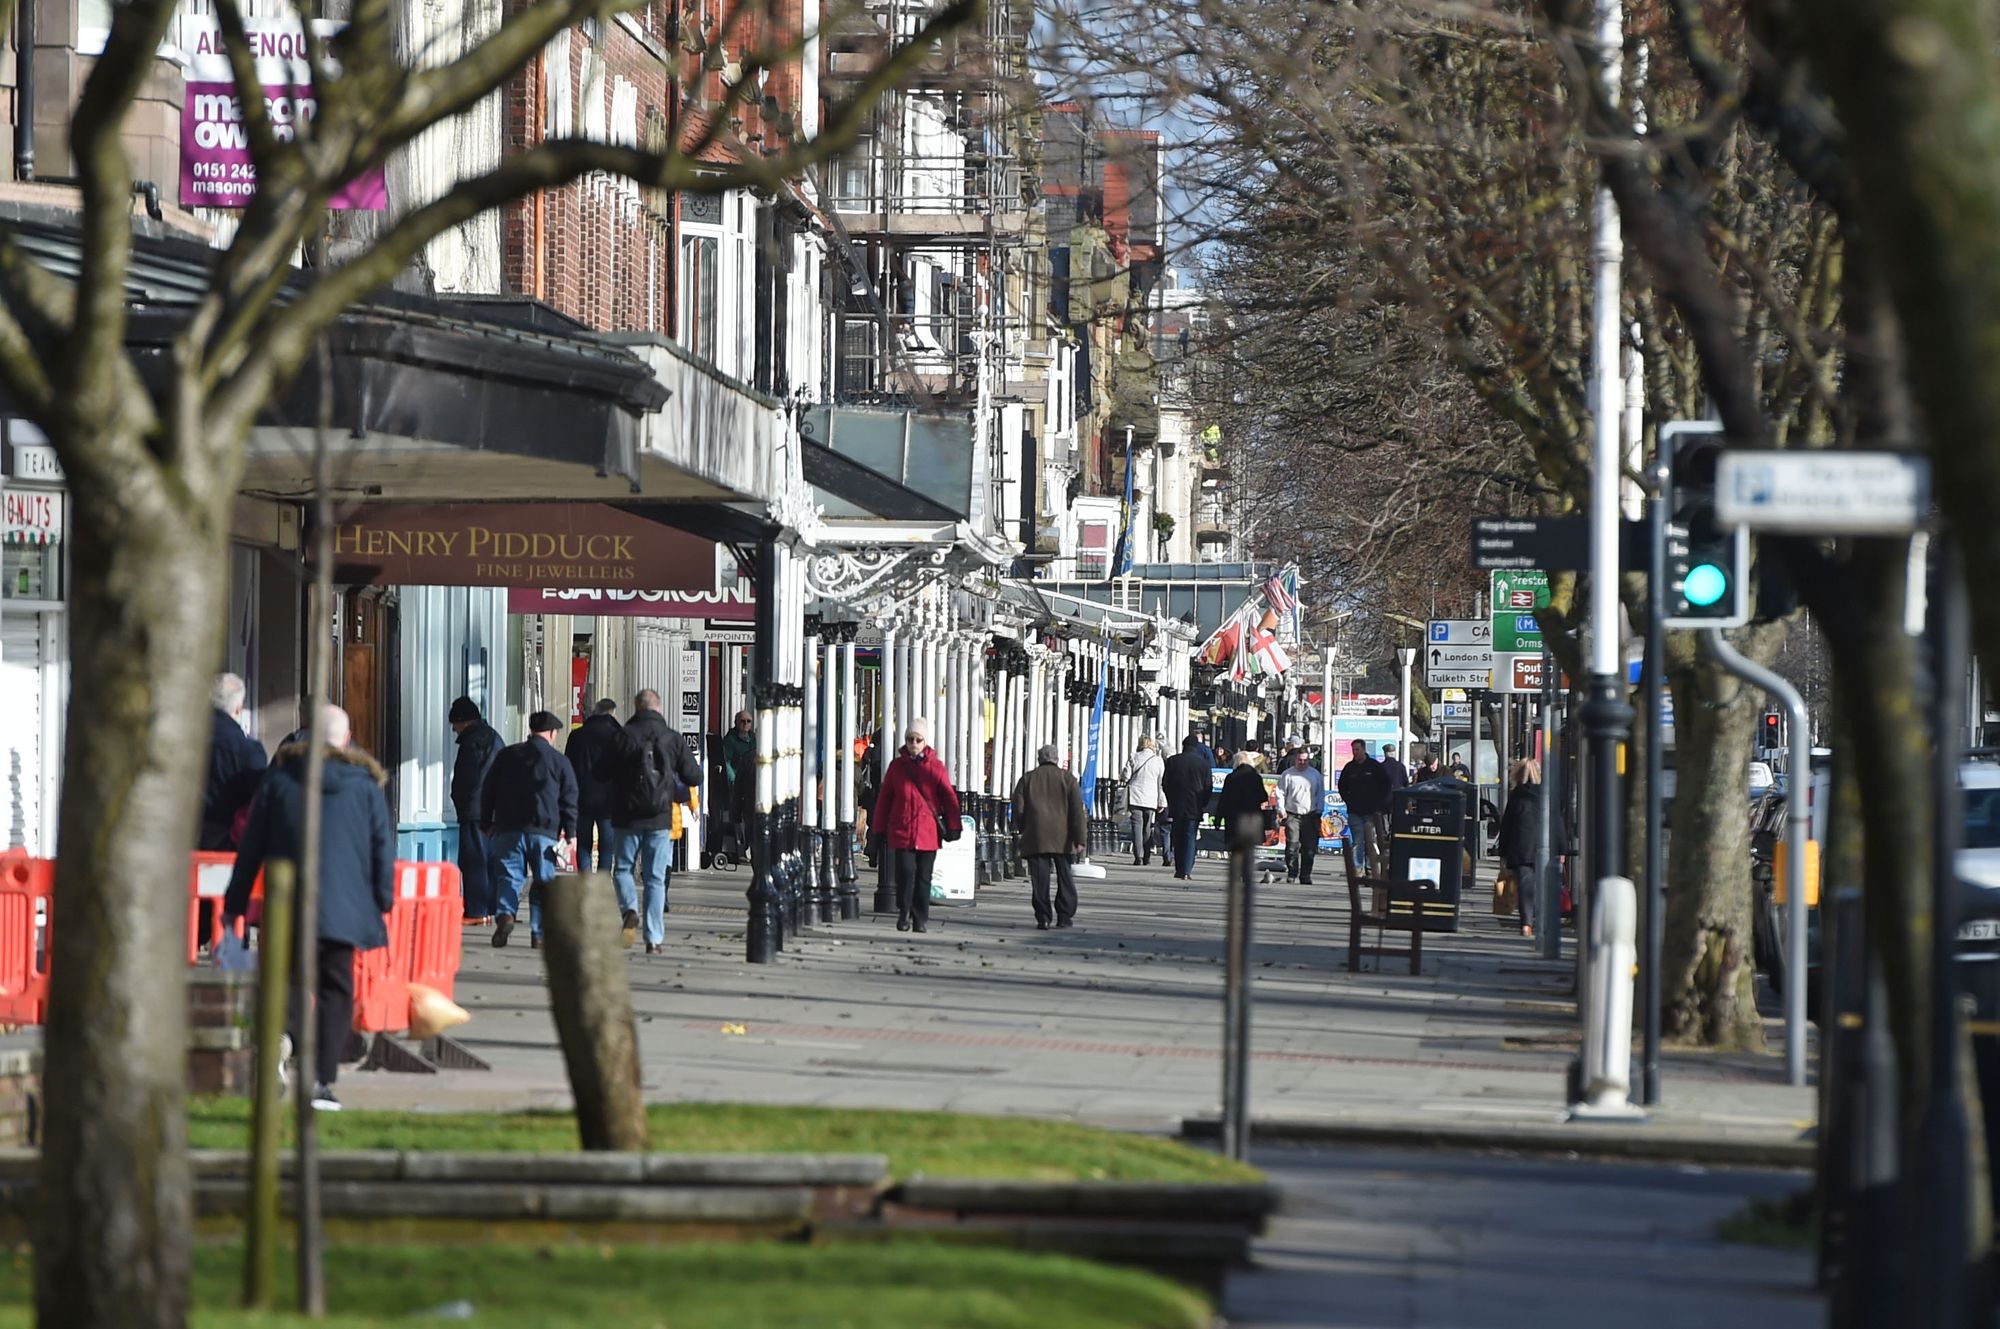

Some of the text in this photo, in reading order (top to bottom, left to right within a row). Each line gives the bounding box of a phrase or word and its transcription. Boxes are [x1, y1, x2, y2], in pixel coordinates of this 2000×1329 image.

[194, 121, 295, 150] own
[193, 162, 226, 178] 0151
[334, 524, 636, 561] HENRY PIDDUCK
[476, 563, 636, 580] FINE JEWELLERS
[703, 632, 757, 641] APPOINTM
[1471, 627, 1490, 637] CA
[1516, 637, 1543, 649] Orms
[1444, 652, 1493, 662] London St
[1431, 674, 1490, 683] Tulketh Stre
[1411, 825, 1441, 834] LITTER
